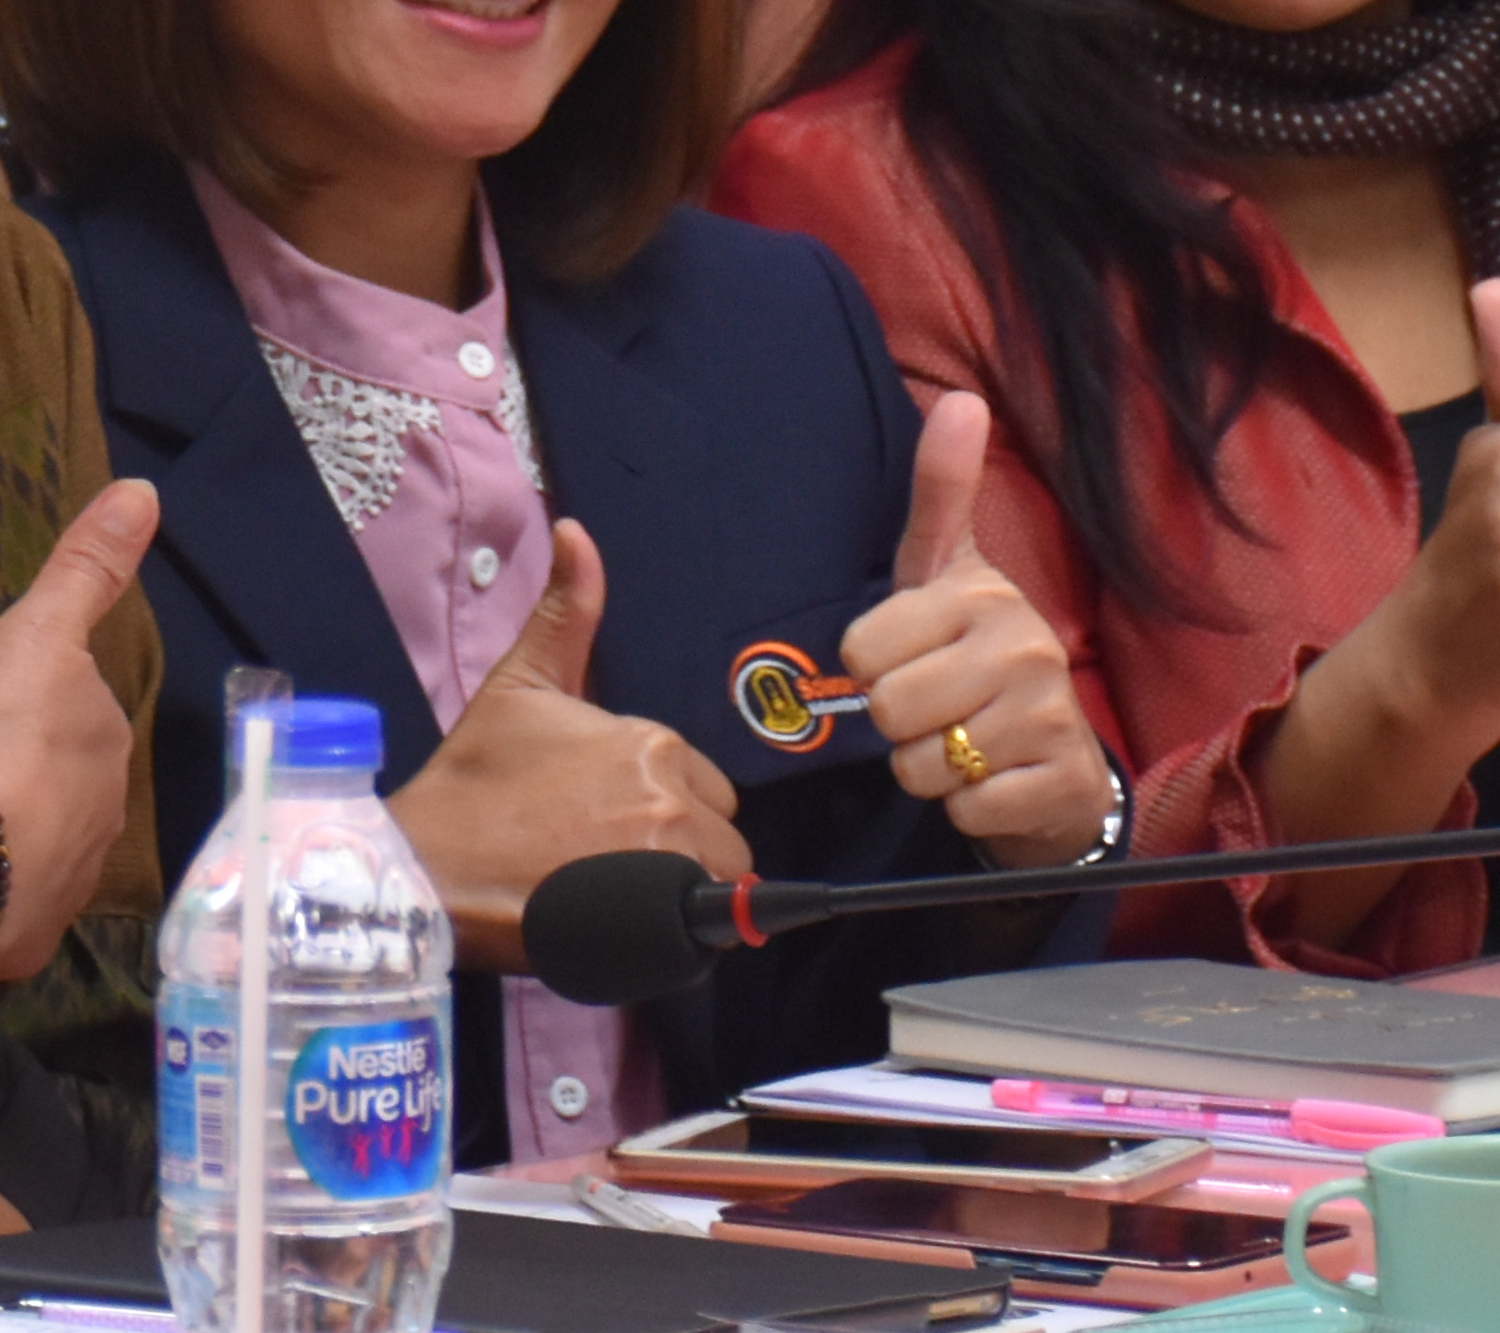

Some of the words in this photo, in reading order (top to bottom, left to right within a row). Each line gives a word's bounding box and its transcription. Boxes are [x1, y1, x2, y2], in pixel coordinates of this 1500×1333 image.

[328, 1036, 429, 1080] Nestlé
[294, 1080, 400, 1124] Pure
[405, 1070, 442, 1132] Life
